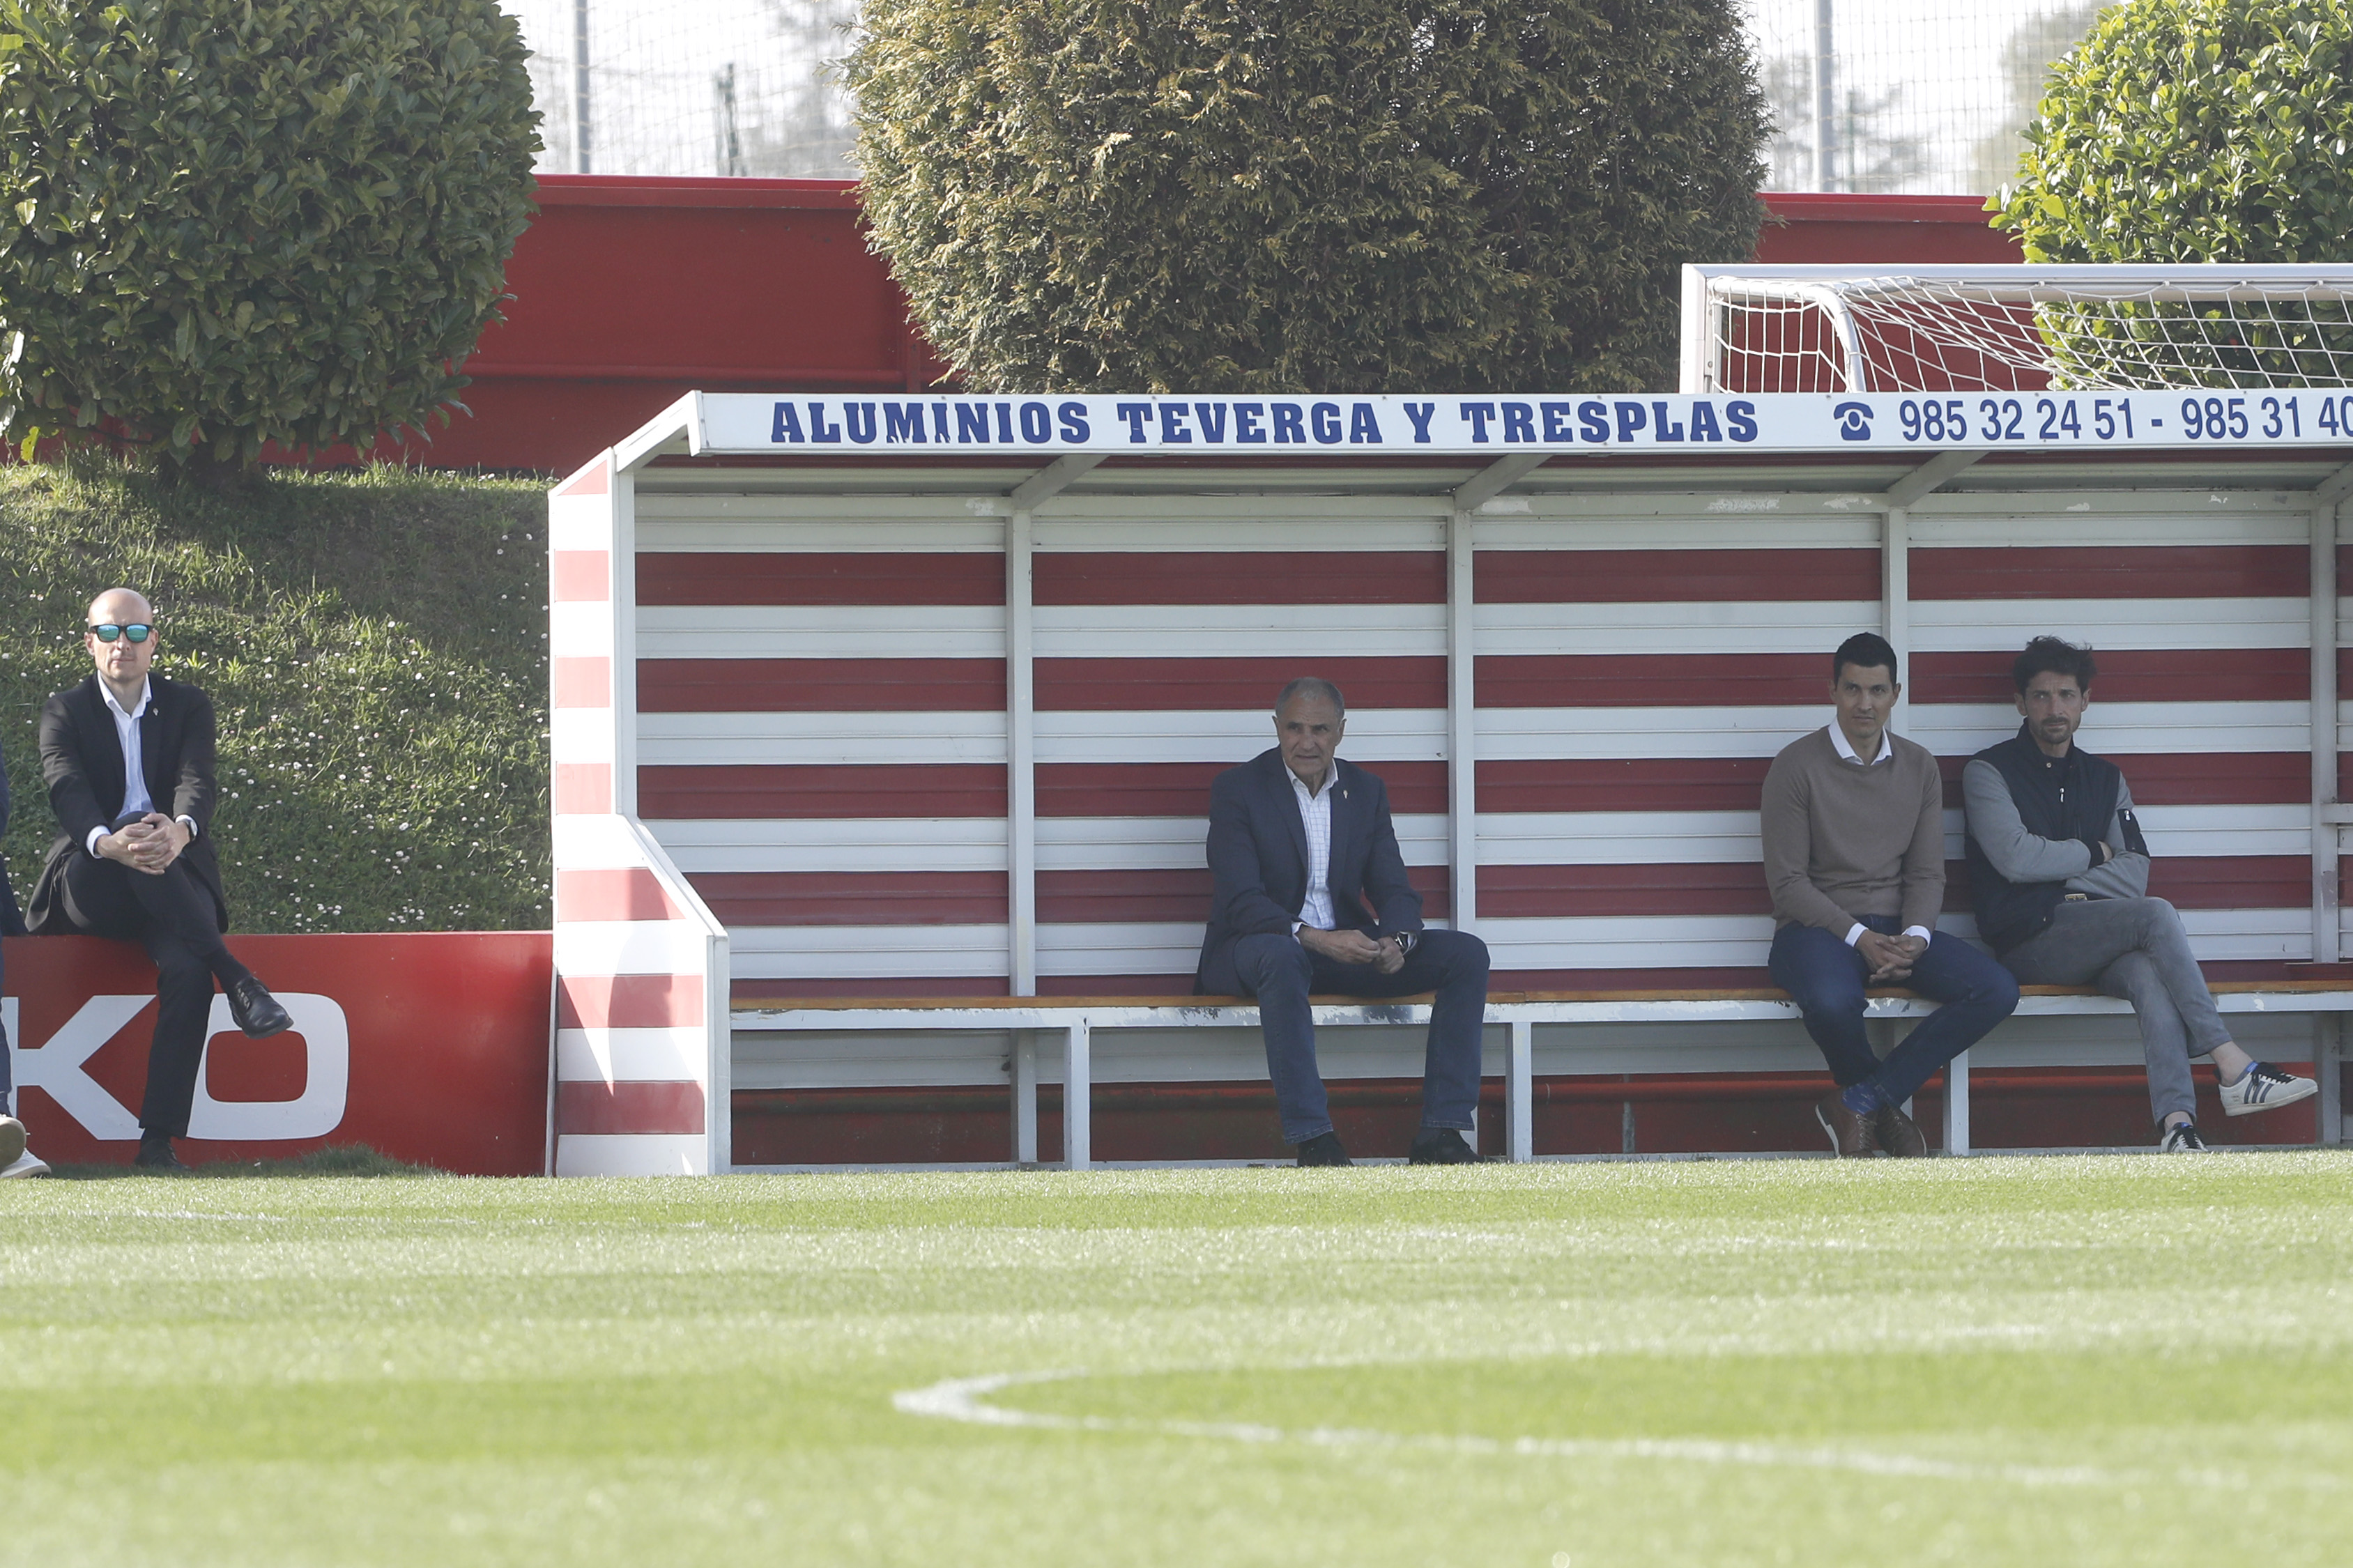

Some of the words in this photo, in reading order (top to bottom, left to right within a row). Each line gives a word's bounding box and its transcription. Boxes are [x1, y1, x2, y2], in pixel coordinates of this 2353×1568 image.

[770, 401, 1091, 445] ALUMINIOS
[1116, 401, 1384, 445] TEVERGA
[1402, 401, 1436, 444] Y
[1459, 400, 1759, 444] TRESPLAS
[1899, 399, 1968, 443] 985
[1979, 398, 2025, 441] 32
[2036, 398, 2083, 440] 24
[2094, 397, 2134, 440] 51
[2180, 397, 2250, 440] 985
[2260, 395, 2301, 439] 31
